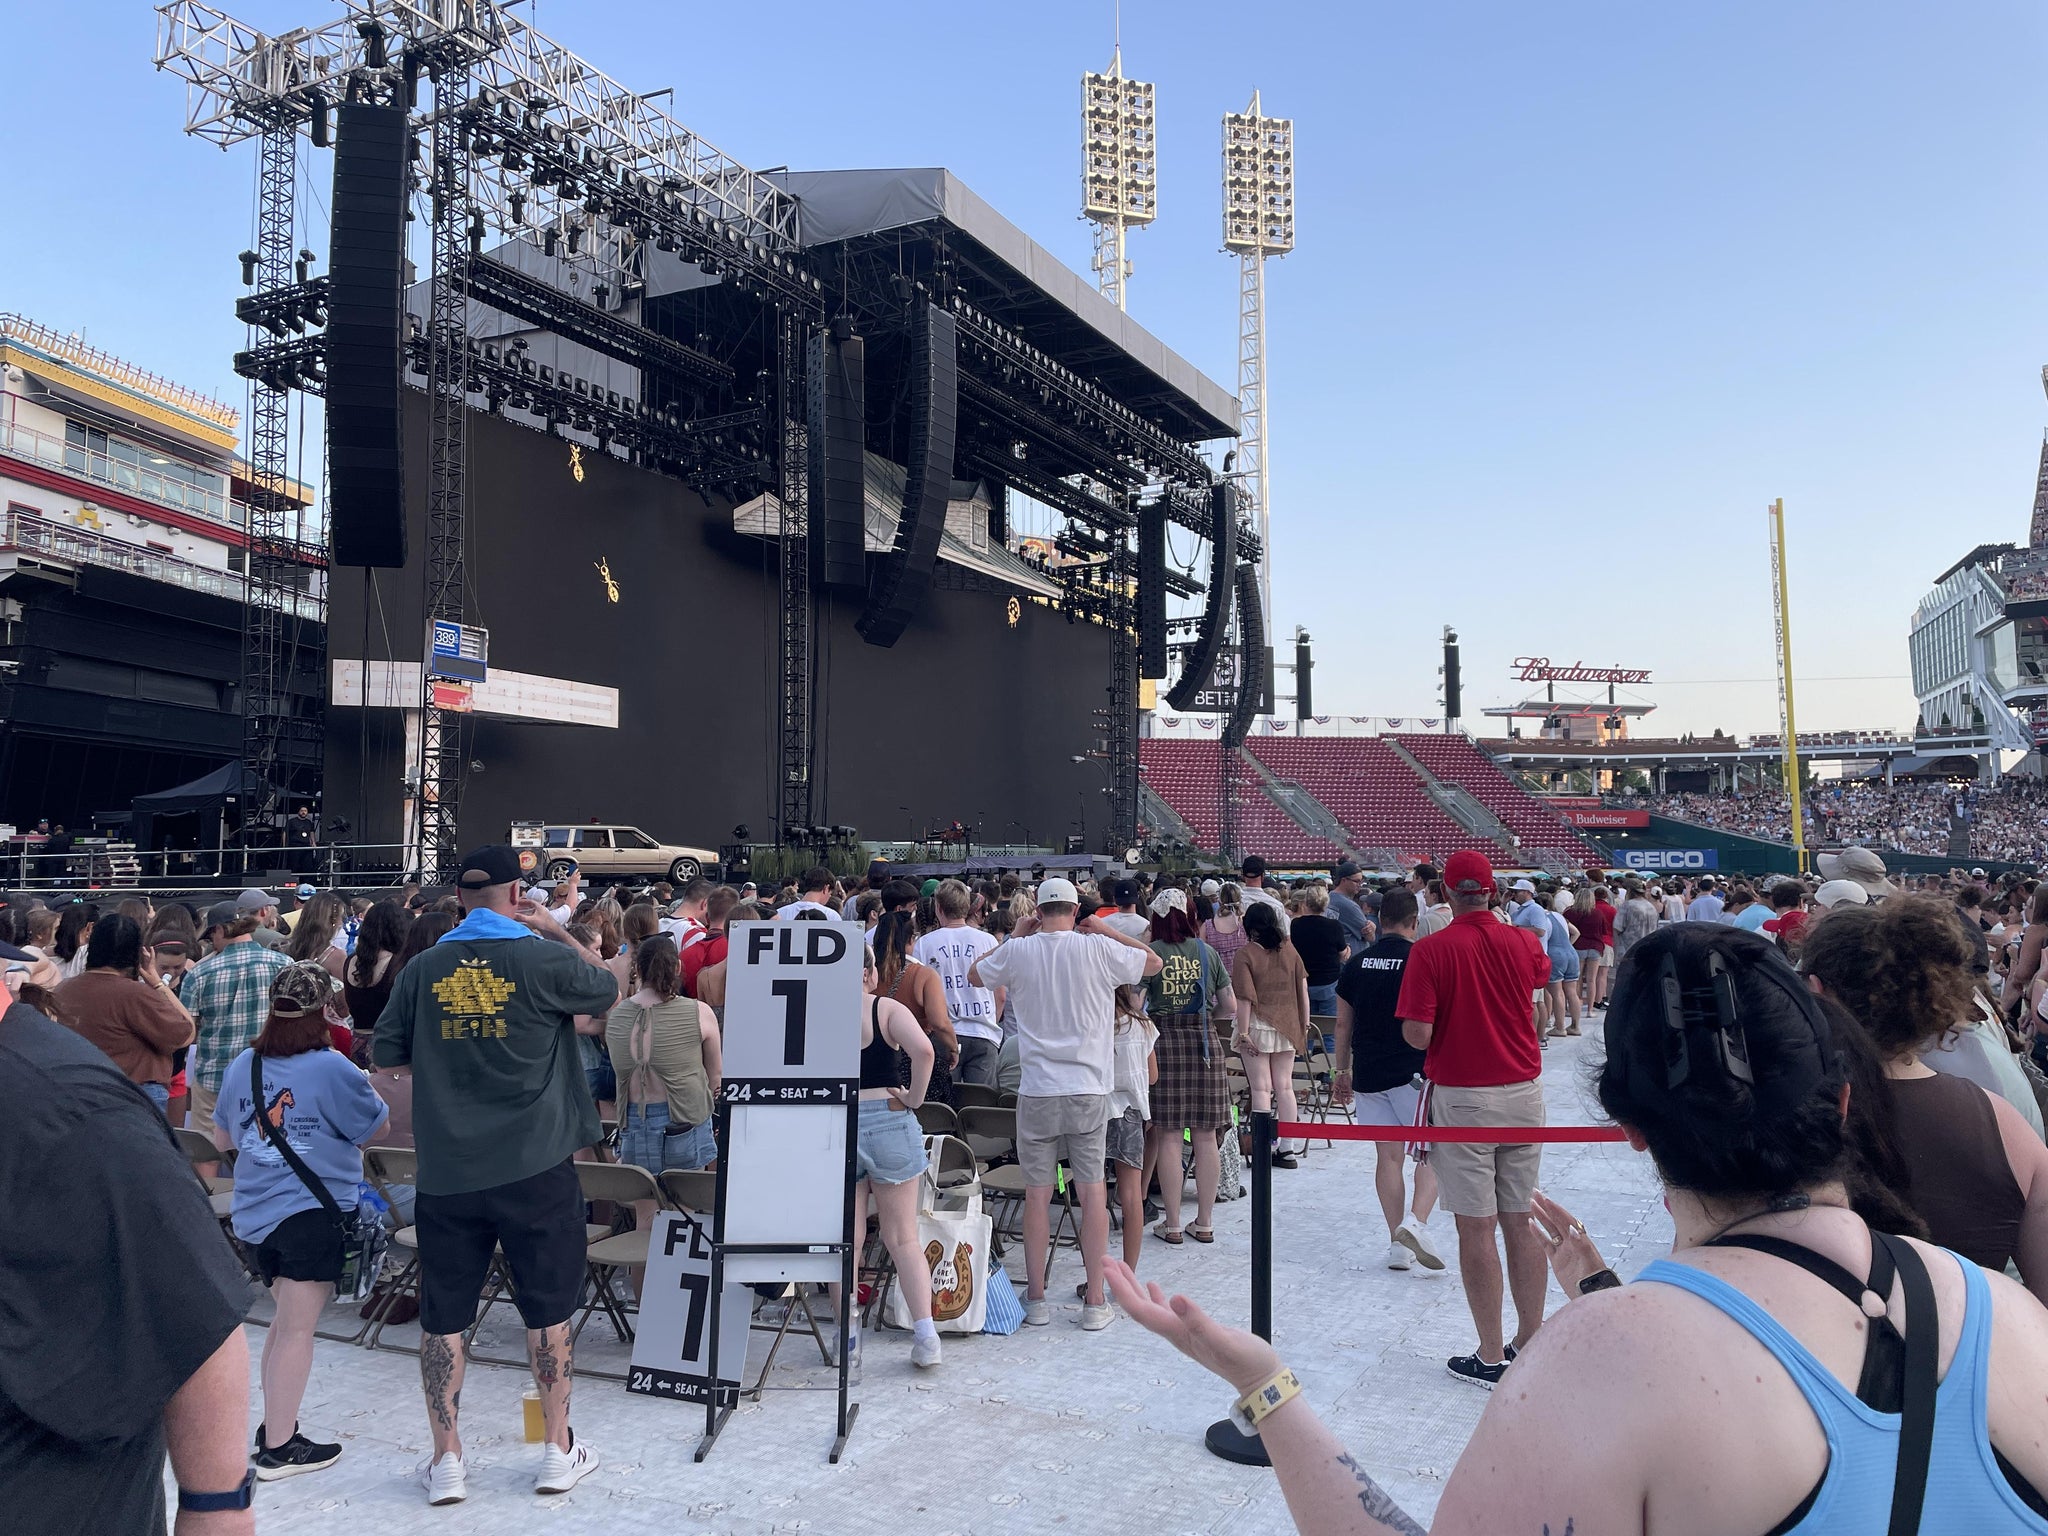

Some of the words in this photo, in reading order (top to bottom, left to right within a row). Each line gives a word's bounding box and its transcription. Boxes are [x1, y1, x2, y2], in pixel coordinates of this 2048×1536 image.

[436, 631, 455, 645] 389
[1514, 657, 1649, 683] Budweiser
[1576, 813, 1628, 825] Budweiser
[1625, 851, 1704, 868] GEICO
[748, 928, 847, 965] FLD
[939, 944, 975, 958] THE
[1170, 955, 1200, 970] The
[1362, 957, 1403, 970] BENNETT
[953, 1001, 991, 1016] VIDE
[1171, 996, 1190, 1006] Tour
[772, 979, 808, 1066] 1
[726, 1083, 751, 1101] 24
[780, 1087, 808, 1099] SEAT
[839, 1083, 847, 1101] 1
[664, 1219, 709, 1260] FL
[955, 1253, 969, 1304] KAHAN
[680, 1273, 710, 1362] 1
[631, 1372, 652, 1392] 24
[674, 1382, 698, 1396] SEAT
